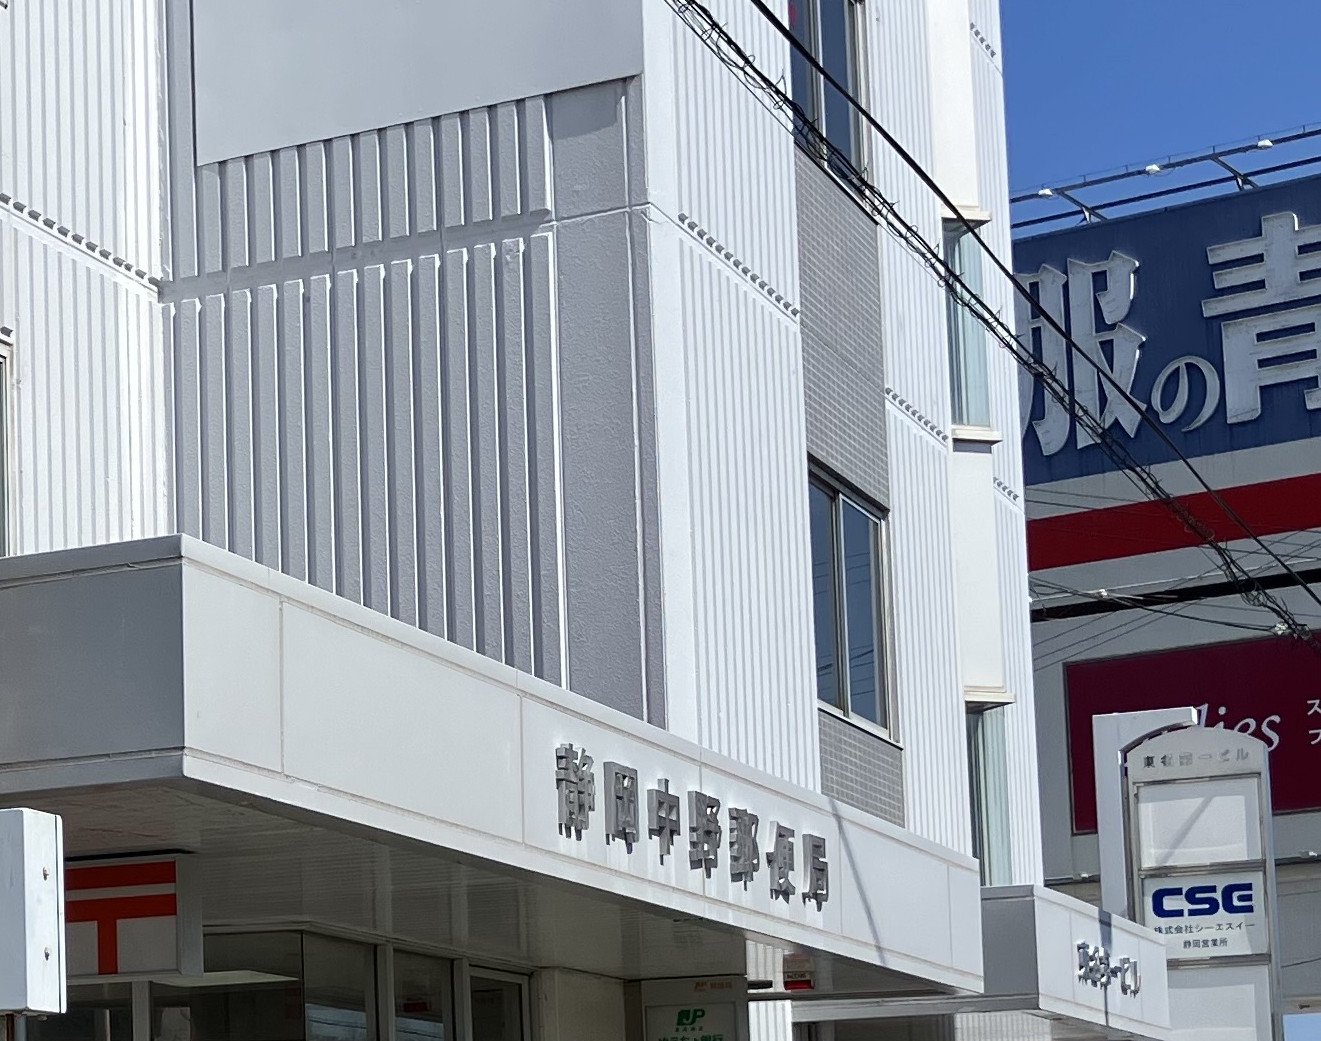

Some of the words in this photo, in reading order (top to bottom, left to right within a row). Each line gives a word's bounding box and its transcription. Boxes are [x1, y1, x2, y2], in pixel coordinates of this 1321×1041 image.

[555, 743, 830, 908] 静岡中野郵便局
[1151, 882, 1254, 918] CSE
